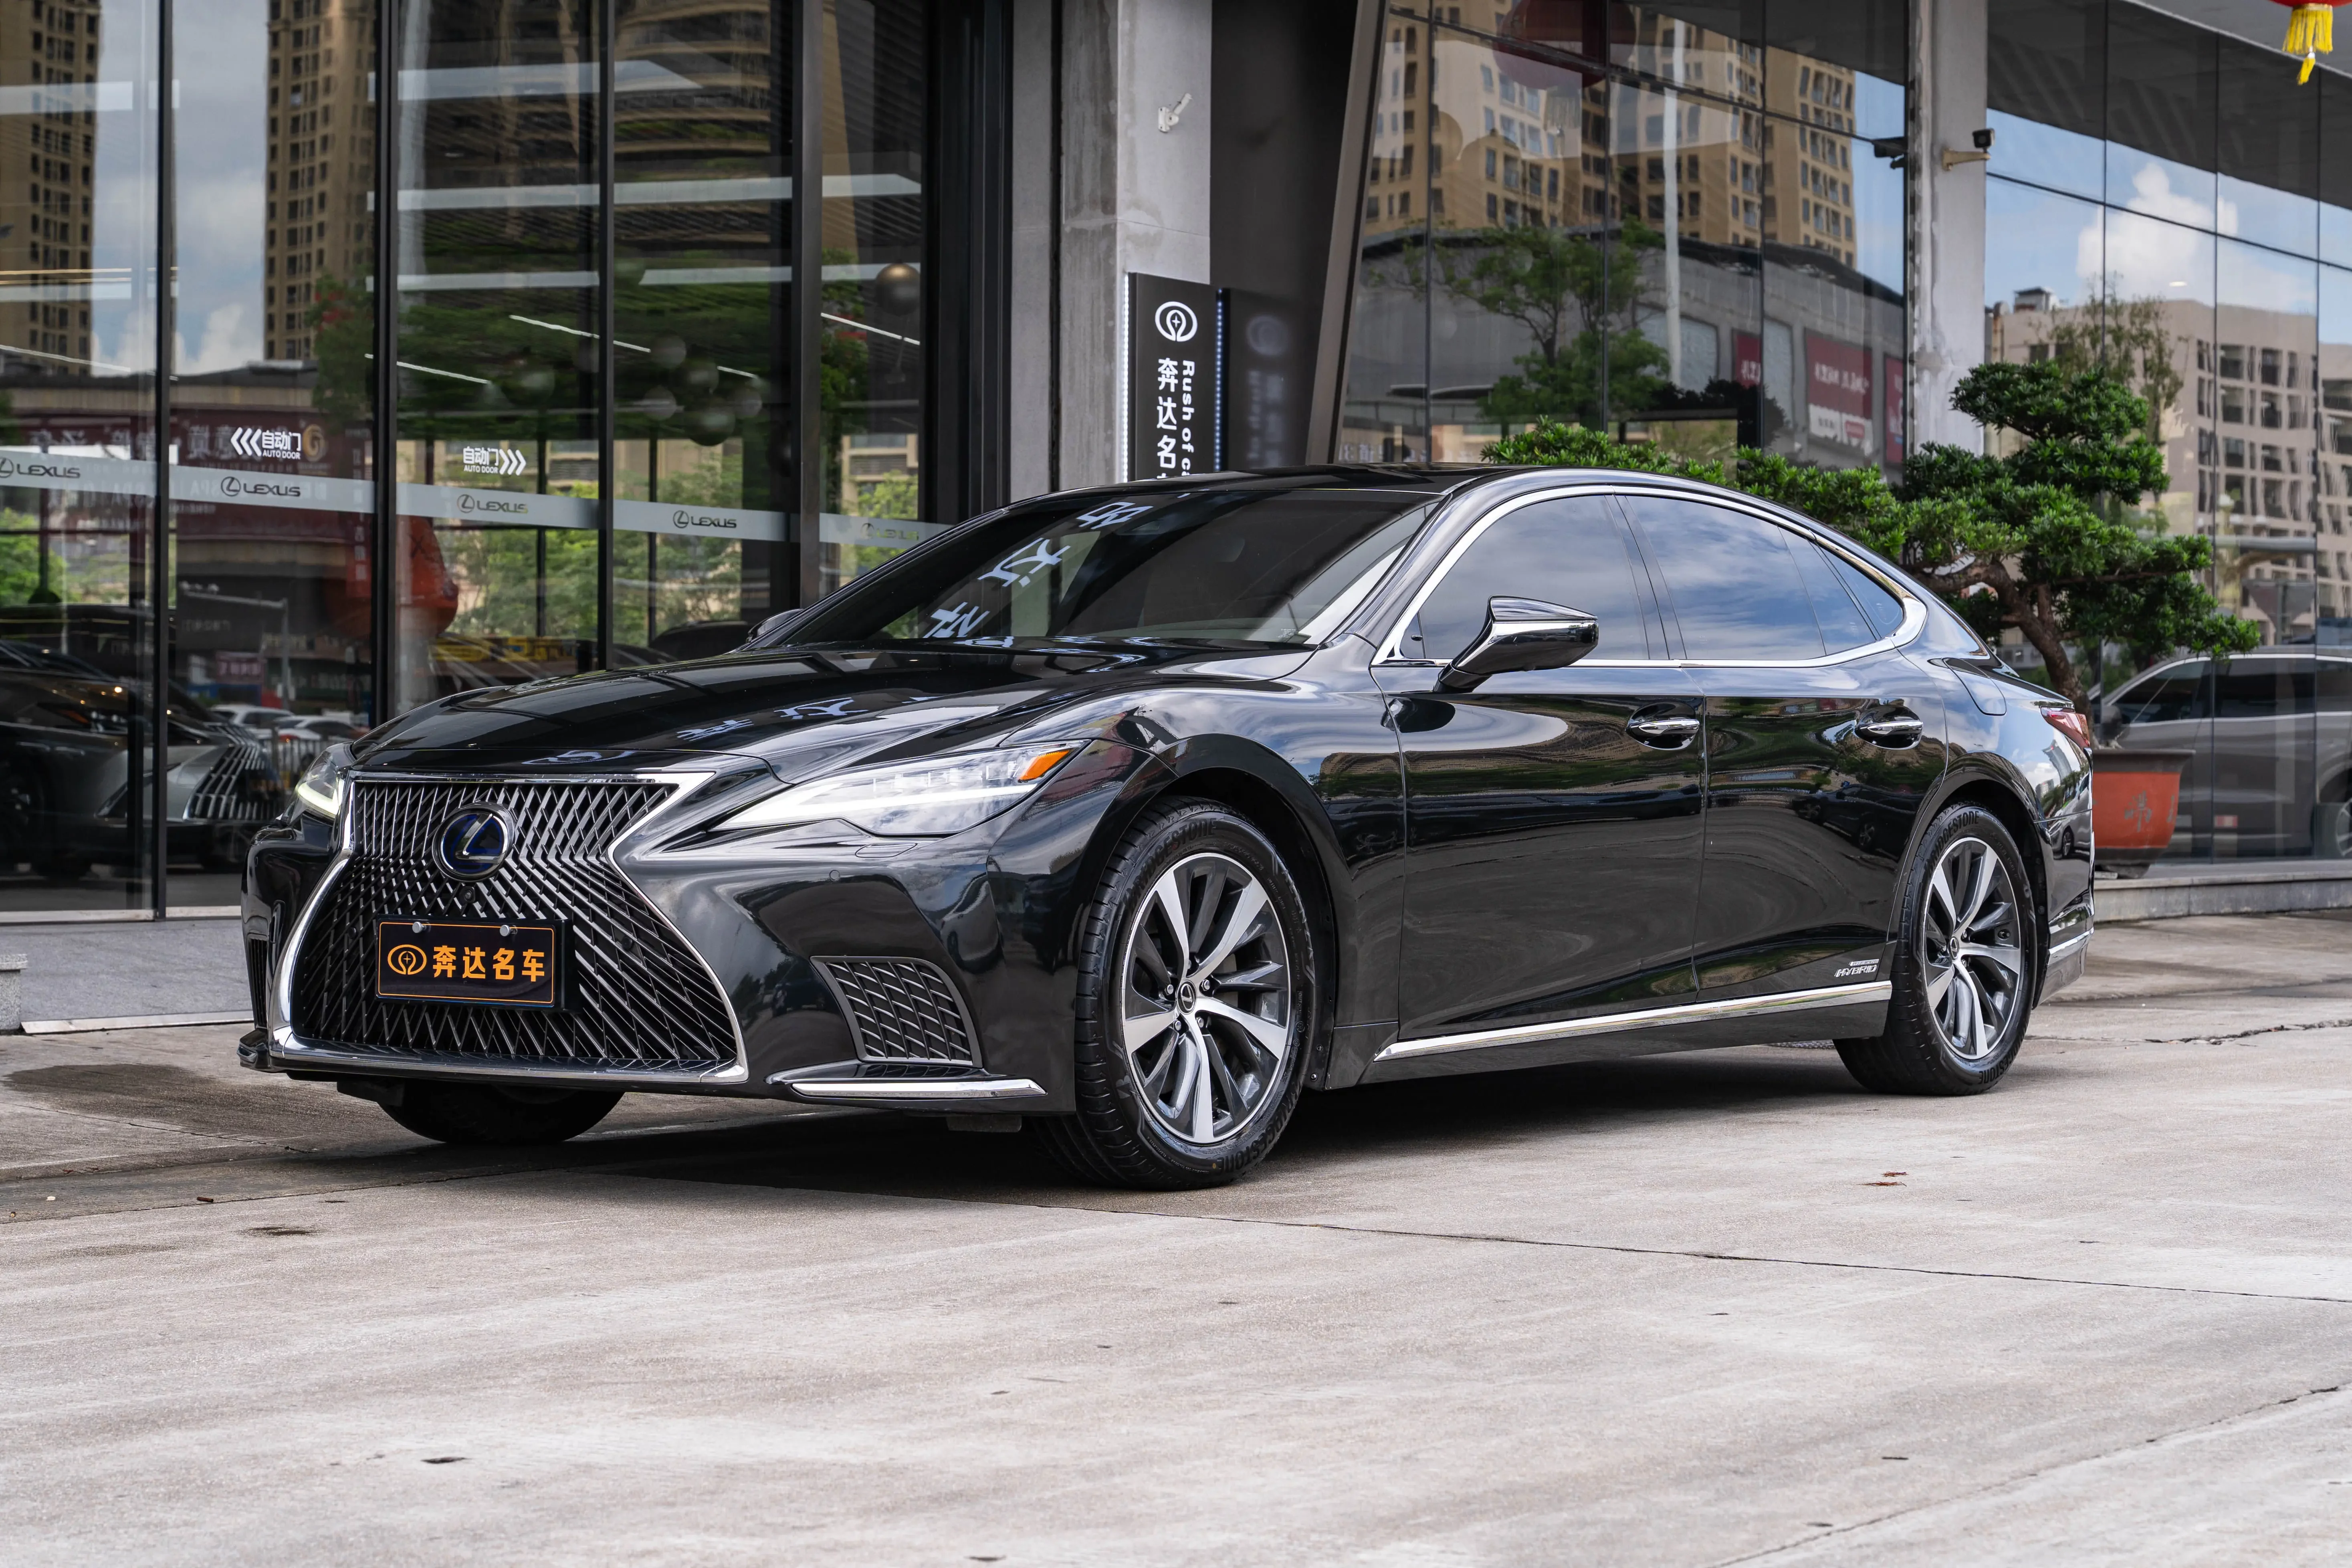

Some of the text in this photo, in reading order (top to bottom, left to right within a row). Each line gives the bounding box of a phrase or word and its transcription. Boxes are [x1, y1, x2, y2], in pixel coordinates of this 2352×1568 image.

[1183, 360, 1195, 421] Rush
[1157, 358, 1178, 479] 奔达名
[262, 430, 301, 451] 自动门
[1182, 428, 1194, 453] of
[262, 450, 301, 459] AUTO DOOR
[463, 446, 499, 466] 自动门
[17, 464, 81, 478] LEXUS
[244, 483, 301, 496] LEXUS
[477, 501, 528, 513] LEXUS
[691, 517, 737, 529] LEXUS
[1925, 811, 1980, 874] BRIDGESTONE
[433, 945, 545, 982] 奔达名车
[1834, 964, 1878, 977] HYBRID
